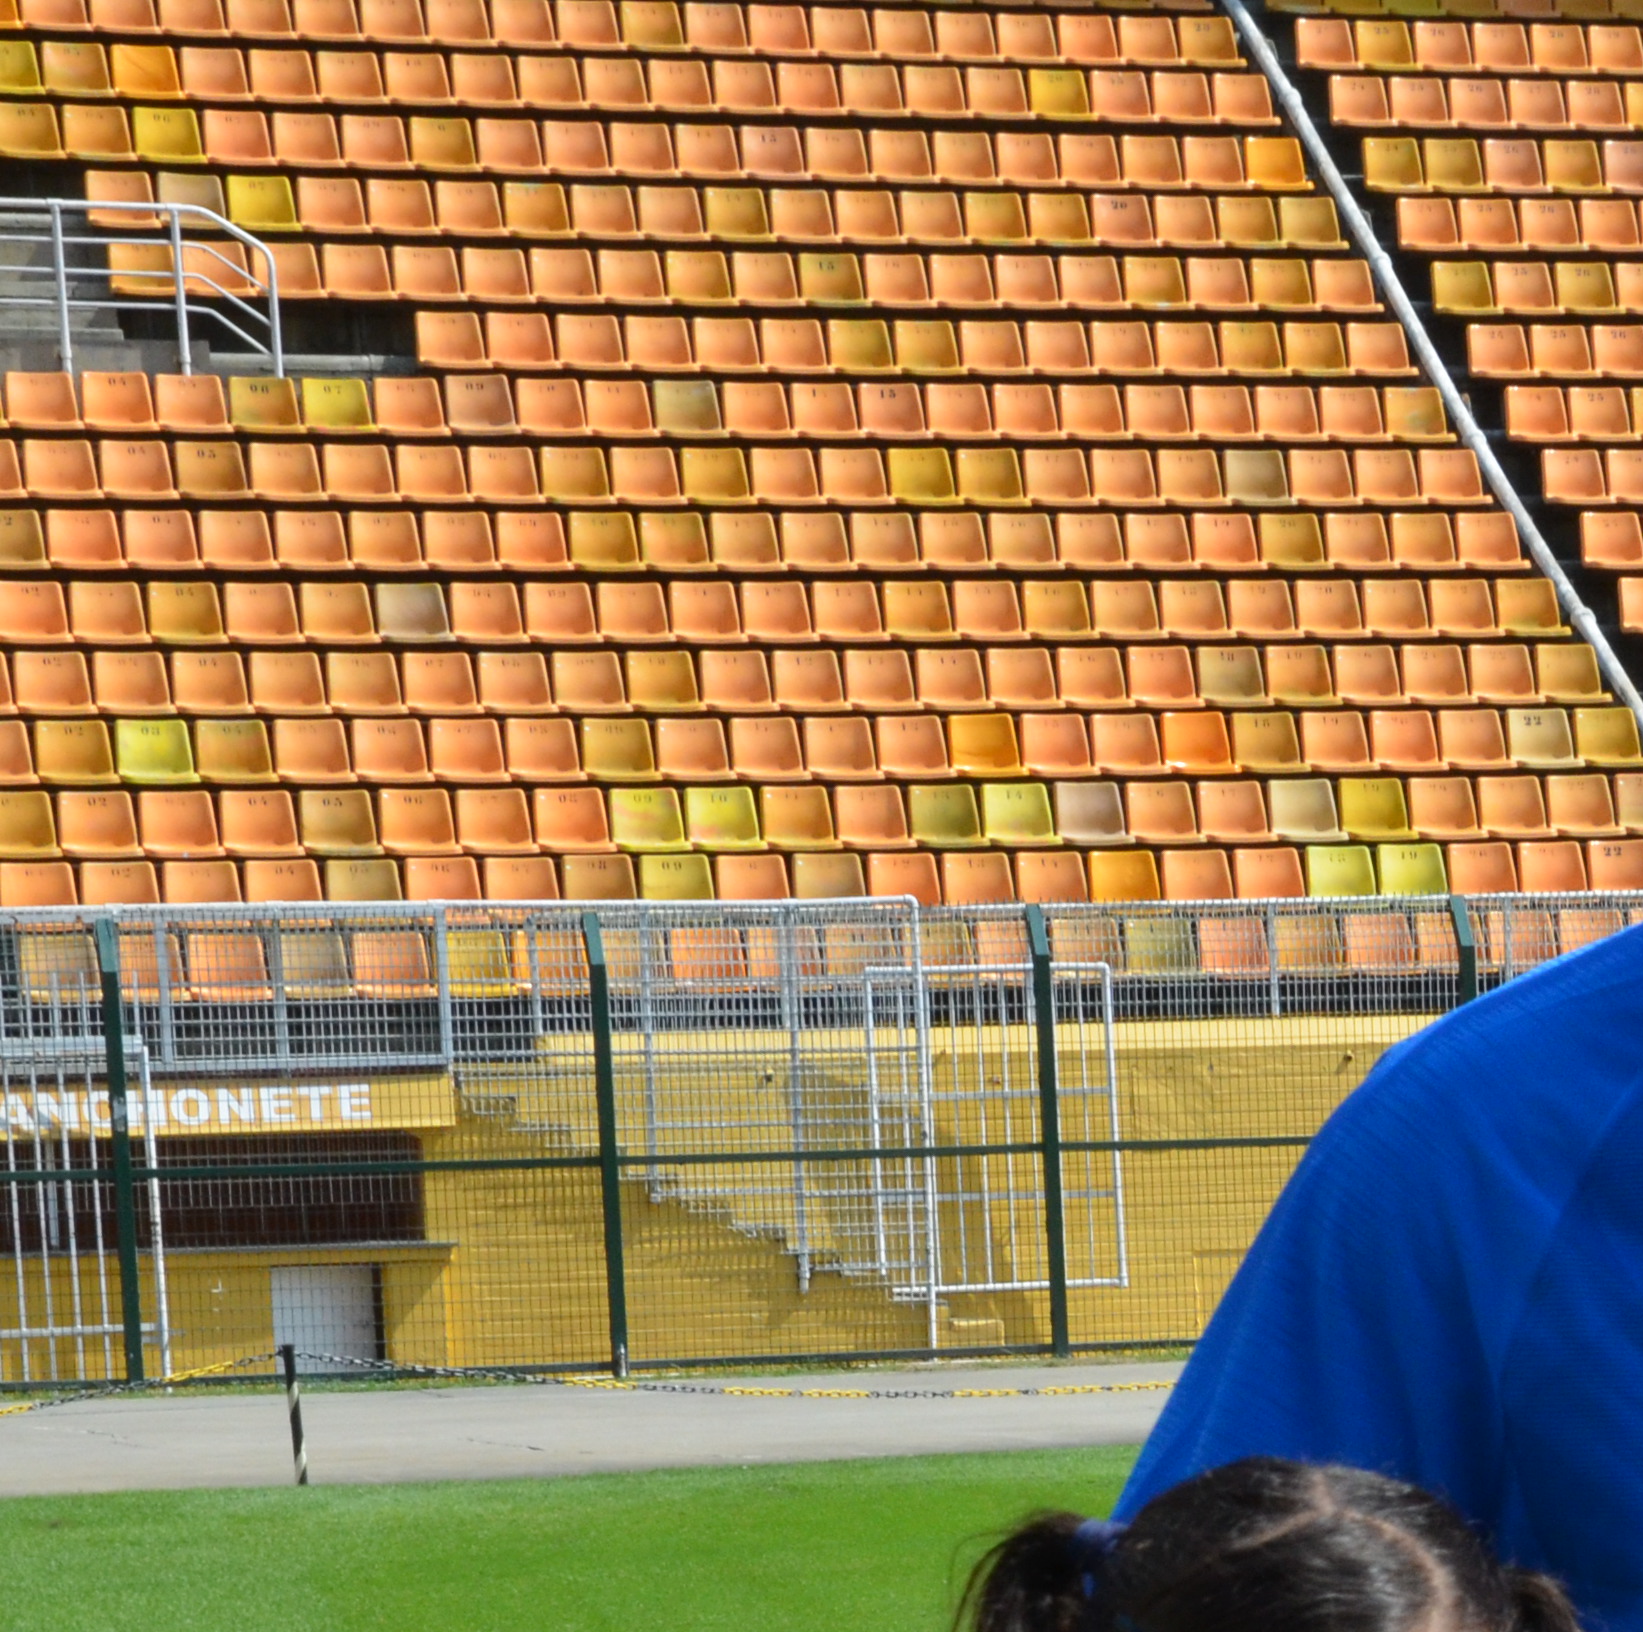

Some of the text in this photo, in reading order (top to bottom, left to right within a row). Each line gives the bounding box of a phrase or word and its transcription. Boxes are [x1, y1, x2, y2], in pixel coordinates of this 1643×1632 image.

[152, 112, 171, 123] 06
[760, 133, 777, 144] 15
[1110, 199, 1128, 211] 20
[249, 383, 269, 394] 06
[322, 384, 341, 395] 07
[879, 388, 897, 400] 15
[196, 448, 217, 459] 05
[1523, 715, 1542, 727] 22
[86, 796, 107, 807] 02
[247, 795, 268, 807] 04
[321, 796, 343, 807] 05
[403, 794, 423, 805] 06
[632, 793, 653, 803] 09
[709, 792, 728, 804] 10
[1400, 850, 1418, 861] 19
[1602, 845, 1622, 857] 22
[661, 860, 683, 871] 09
